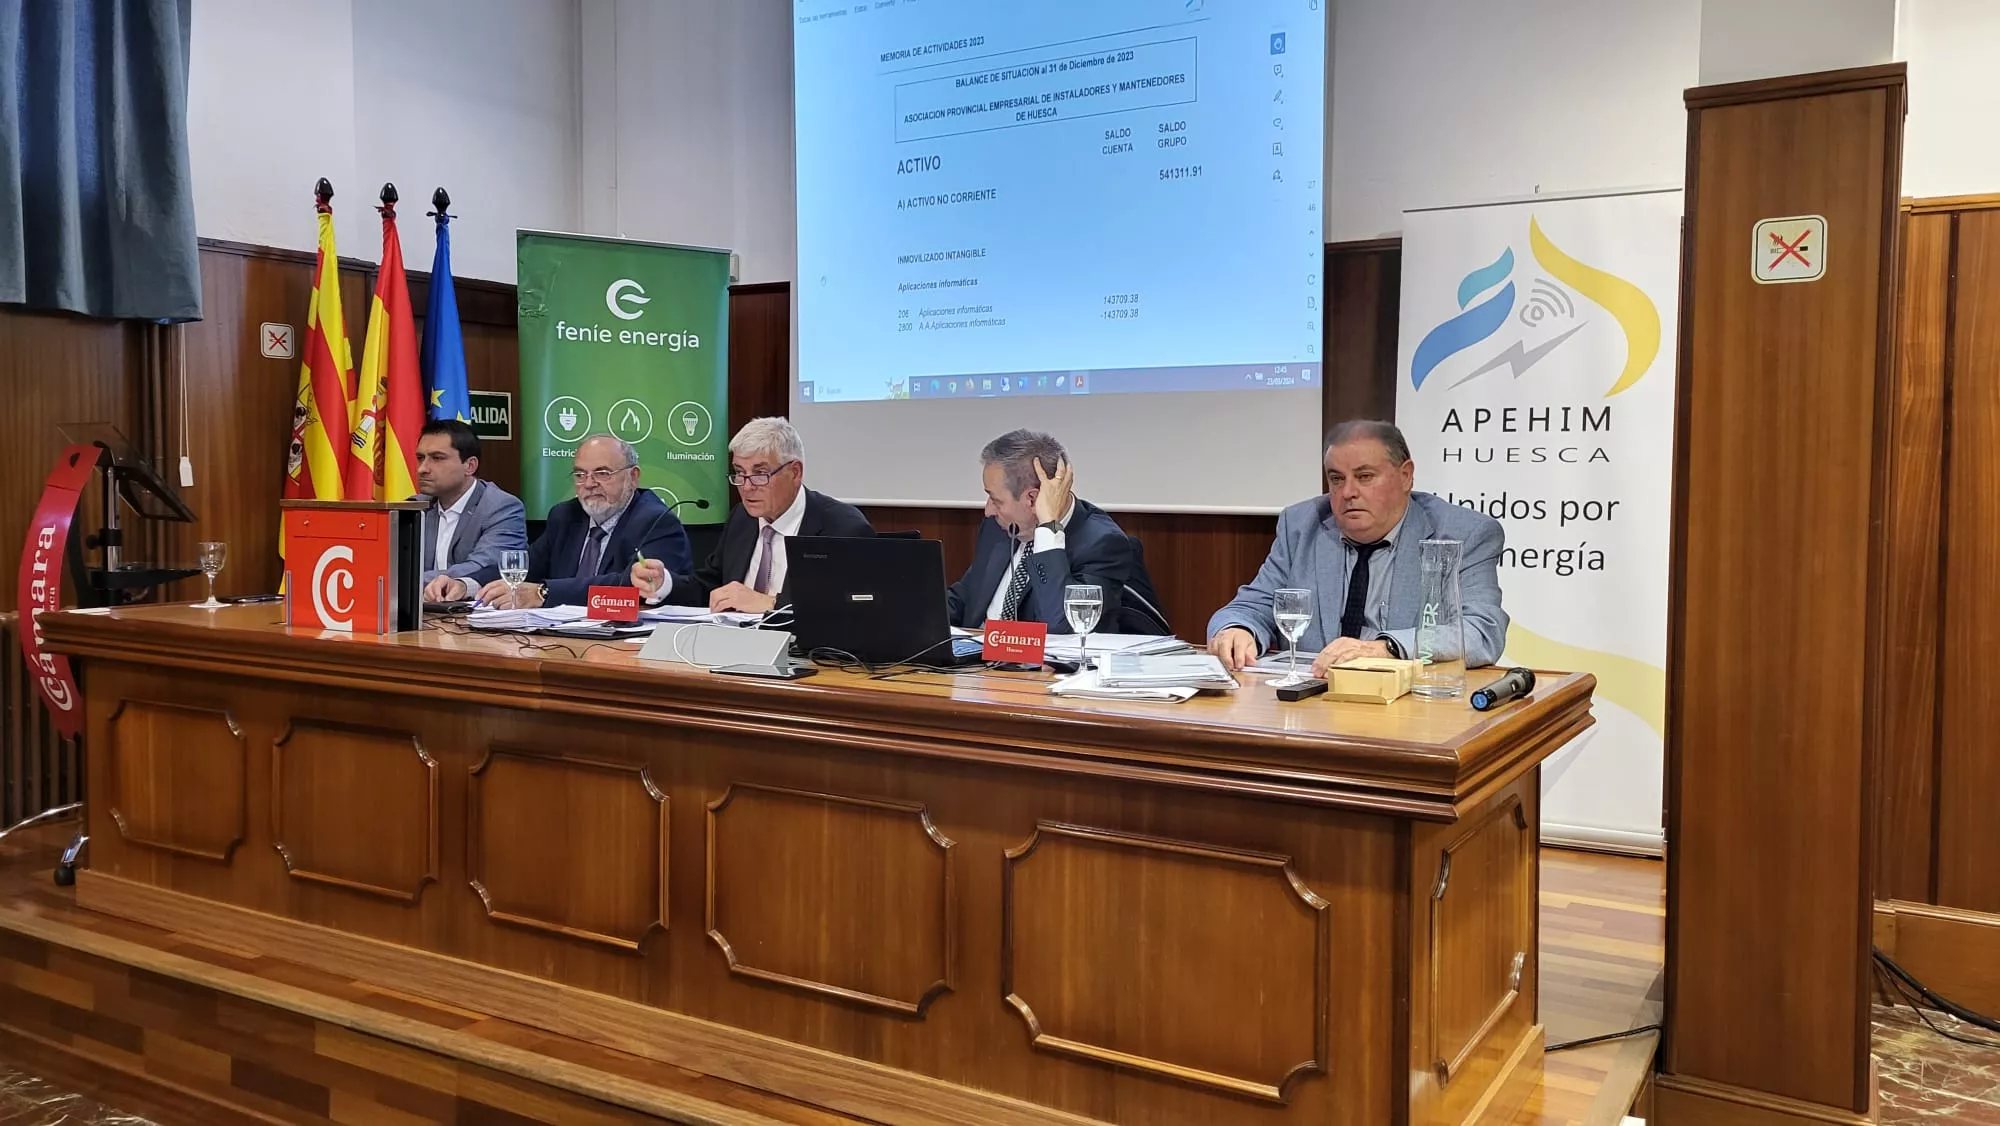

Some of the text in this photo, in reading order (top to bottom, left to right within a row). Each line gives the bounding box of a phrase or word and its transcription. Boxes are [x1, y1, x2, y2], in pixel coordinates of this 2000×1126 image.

[880, 36, 985, 63] MEMORIA DE ACTIVIDADES 2023
[956, 51, 1134, 88] BALANCE DE SITUACION al 31 de Diciembre de 2023
[904, 73, 1185, 124] ASOCIACION PROVINCIAL EMPRESARIAL DE INSTALADORES Y MANTENEDORES
[1015, 107, 1058, 122] DE HUESCA
[1104, 128, 1131, 140] SALDO
[1158, 121, 1187, 133] SALDO
[1102, 142, 1134, 156] CUENTA
[1157, 136, 1187, 149] GRUPO
[897, 155, 941, 175] ACTIVO
[1159, 166, 1203, 181] 541311.91
[897, 188, 997, 211] A) ACTIVO NO CORRIENTE
[897, 248, 987, 265] INMOVILIZADO INTANGIBLE
[898, 276, 979, 293] Aplicaciones informáticas
[1103, 293, 1139, 305] 143709.38
[919, 305, 956, 318] Aplicaciones
[556, 321, 700, 352] feníe energía
[470, 406, 508, 424] ALIDA
[1441, 405, 1612, 433] APEHIM
[542, 447, 577, 458] Electric
[667, 450, 715, 462] Iluminación
[1442, 447, 1611, 463] HUESCA
[1560, 499, 1620, 528] por
[1499, 541, 1605, 577] nergía
